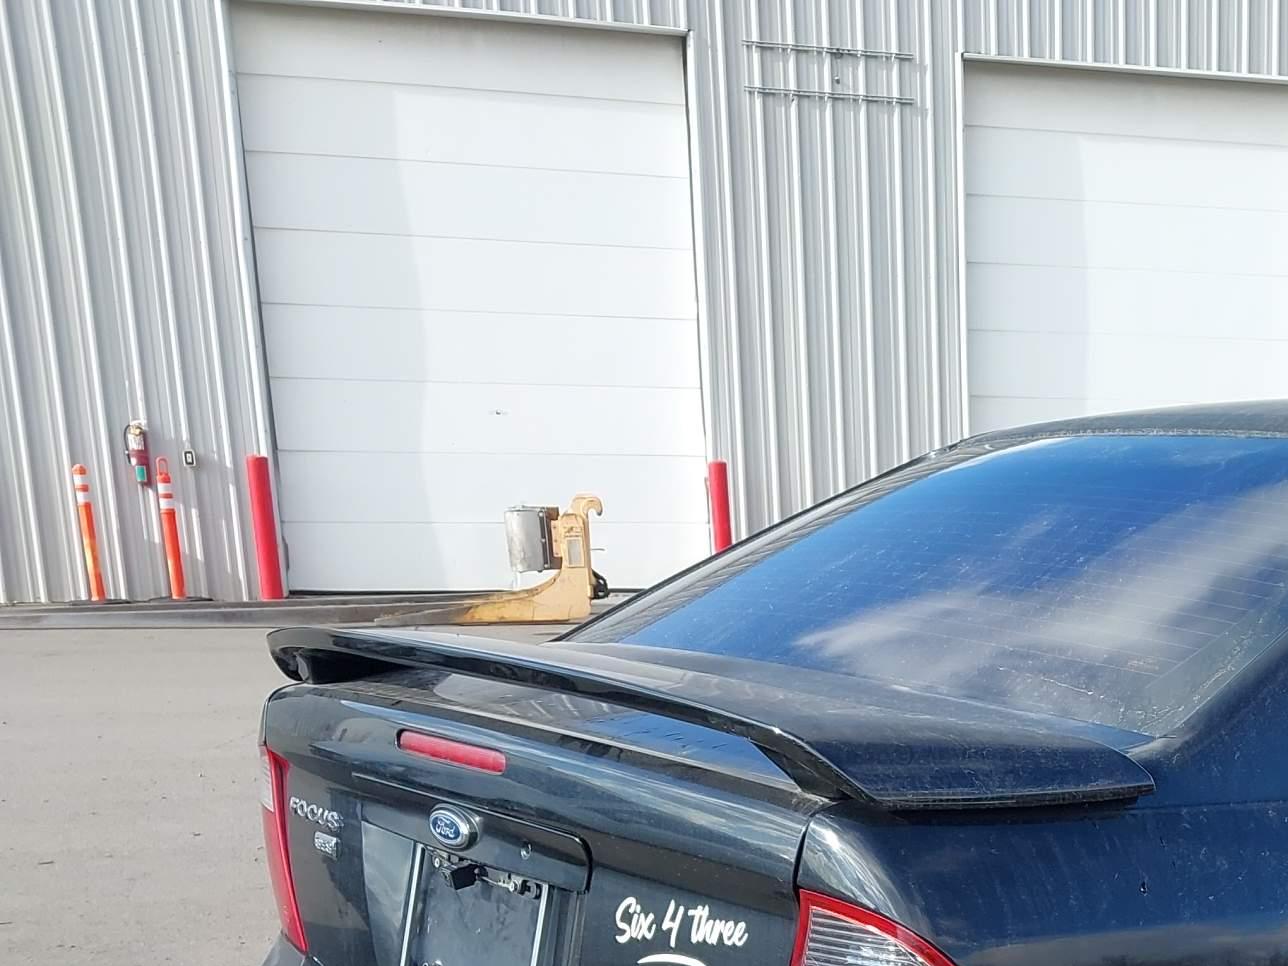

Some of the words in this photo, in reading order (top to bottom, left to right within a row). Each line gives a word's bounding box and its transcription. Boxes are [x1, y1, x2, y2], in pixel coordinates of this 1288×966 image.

[289, 796, 342, 830] FOCUS
[435, 816, 456, 838] Ford
[615, 896, 656, 943] Six
[661, 899, 684, 948] 4
[687, 904, 748, 946] three
